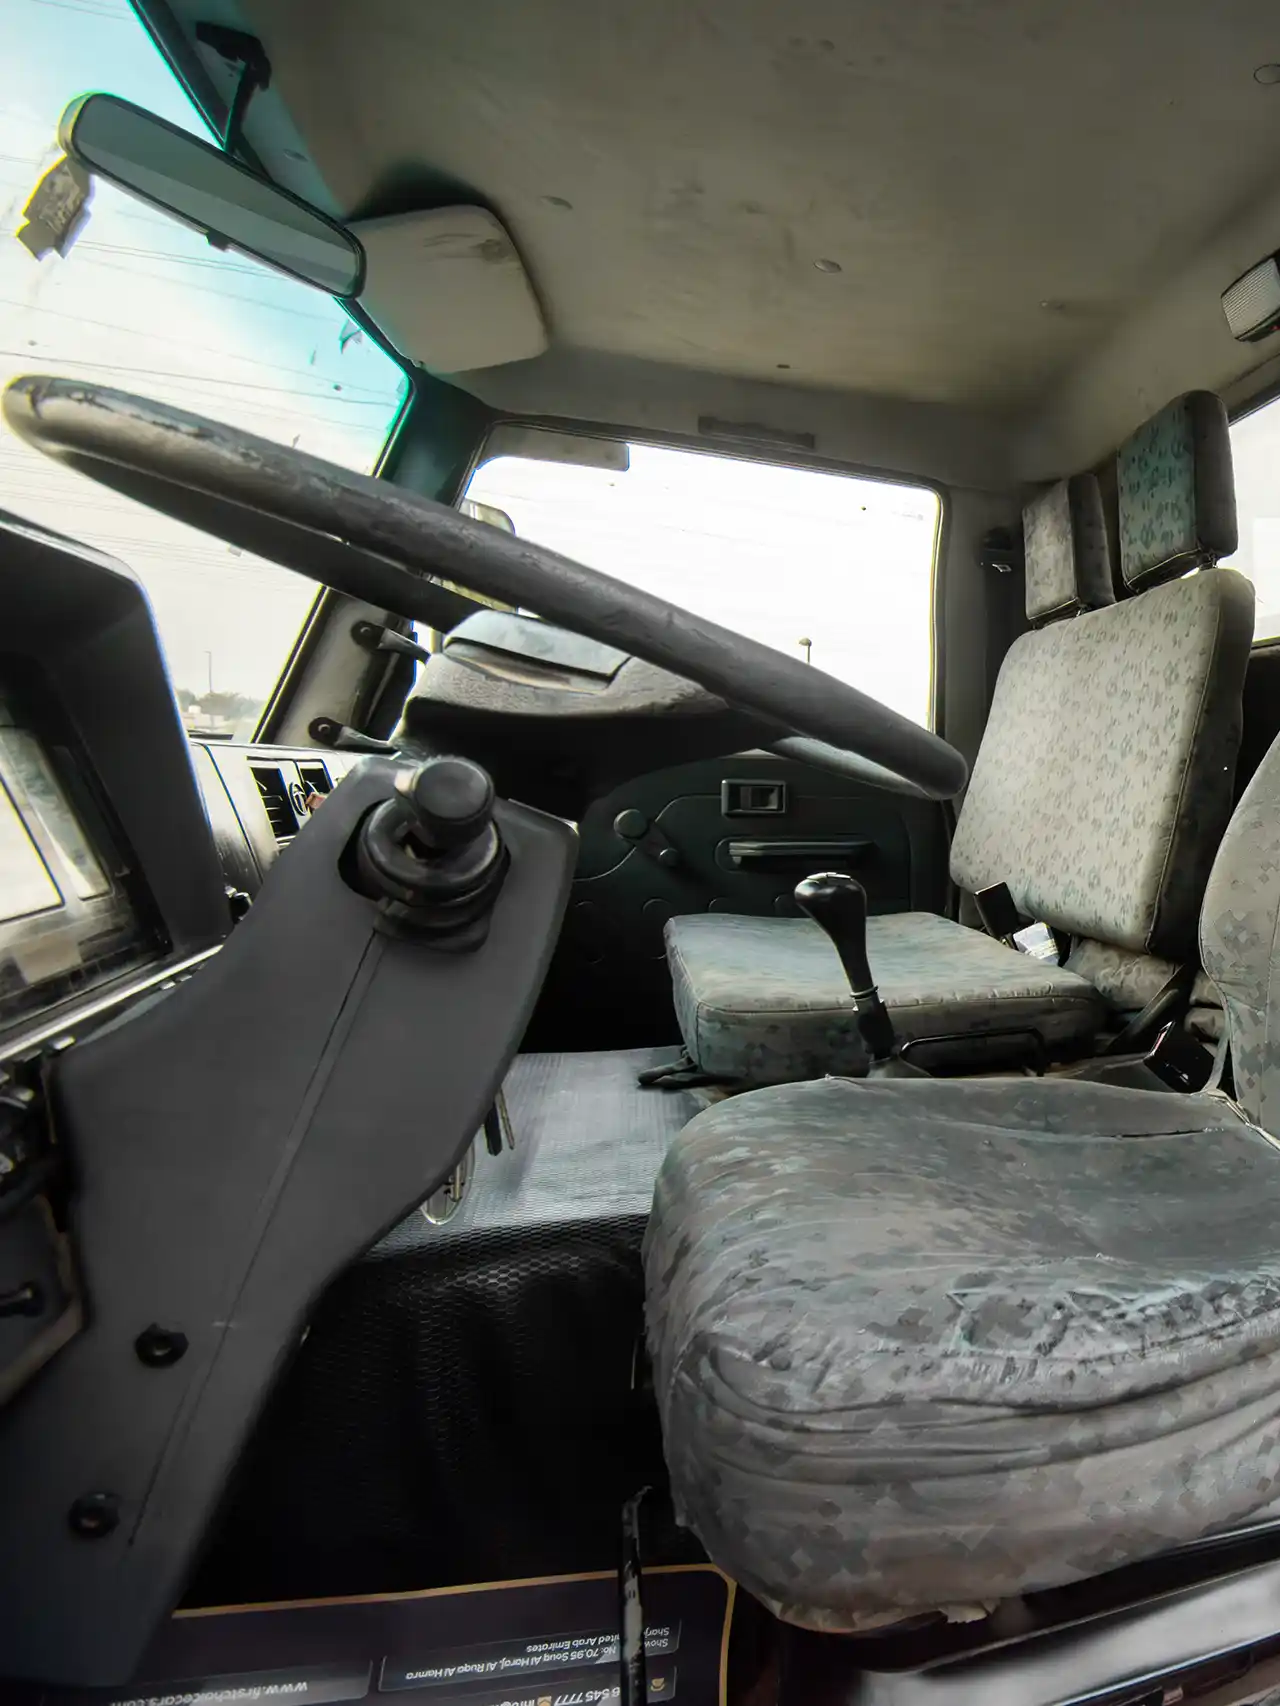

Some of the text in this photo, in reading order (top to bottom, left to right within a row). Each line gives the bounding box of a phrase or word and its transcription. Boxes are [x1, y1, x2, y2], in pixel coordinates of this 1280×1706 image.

[526, 1640, 571, 1653] Emirates
[572, 1636, 597, 1647] Arab
[486, 1661, 498, 1671] Al
[531, 1656, 542, 1665] Al
[405, 1669, 442, 1680] Hamra
[444, 1666, 456, 1677] Al
[585, 1687, 610, 1702] 545
